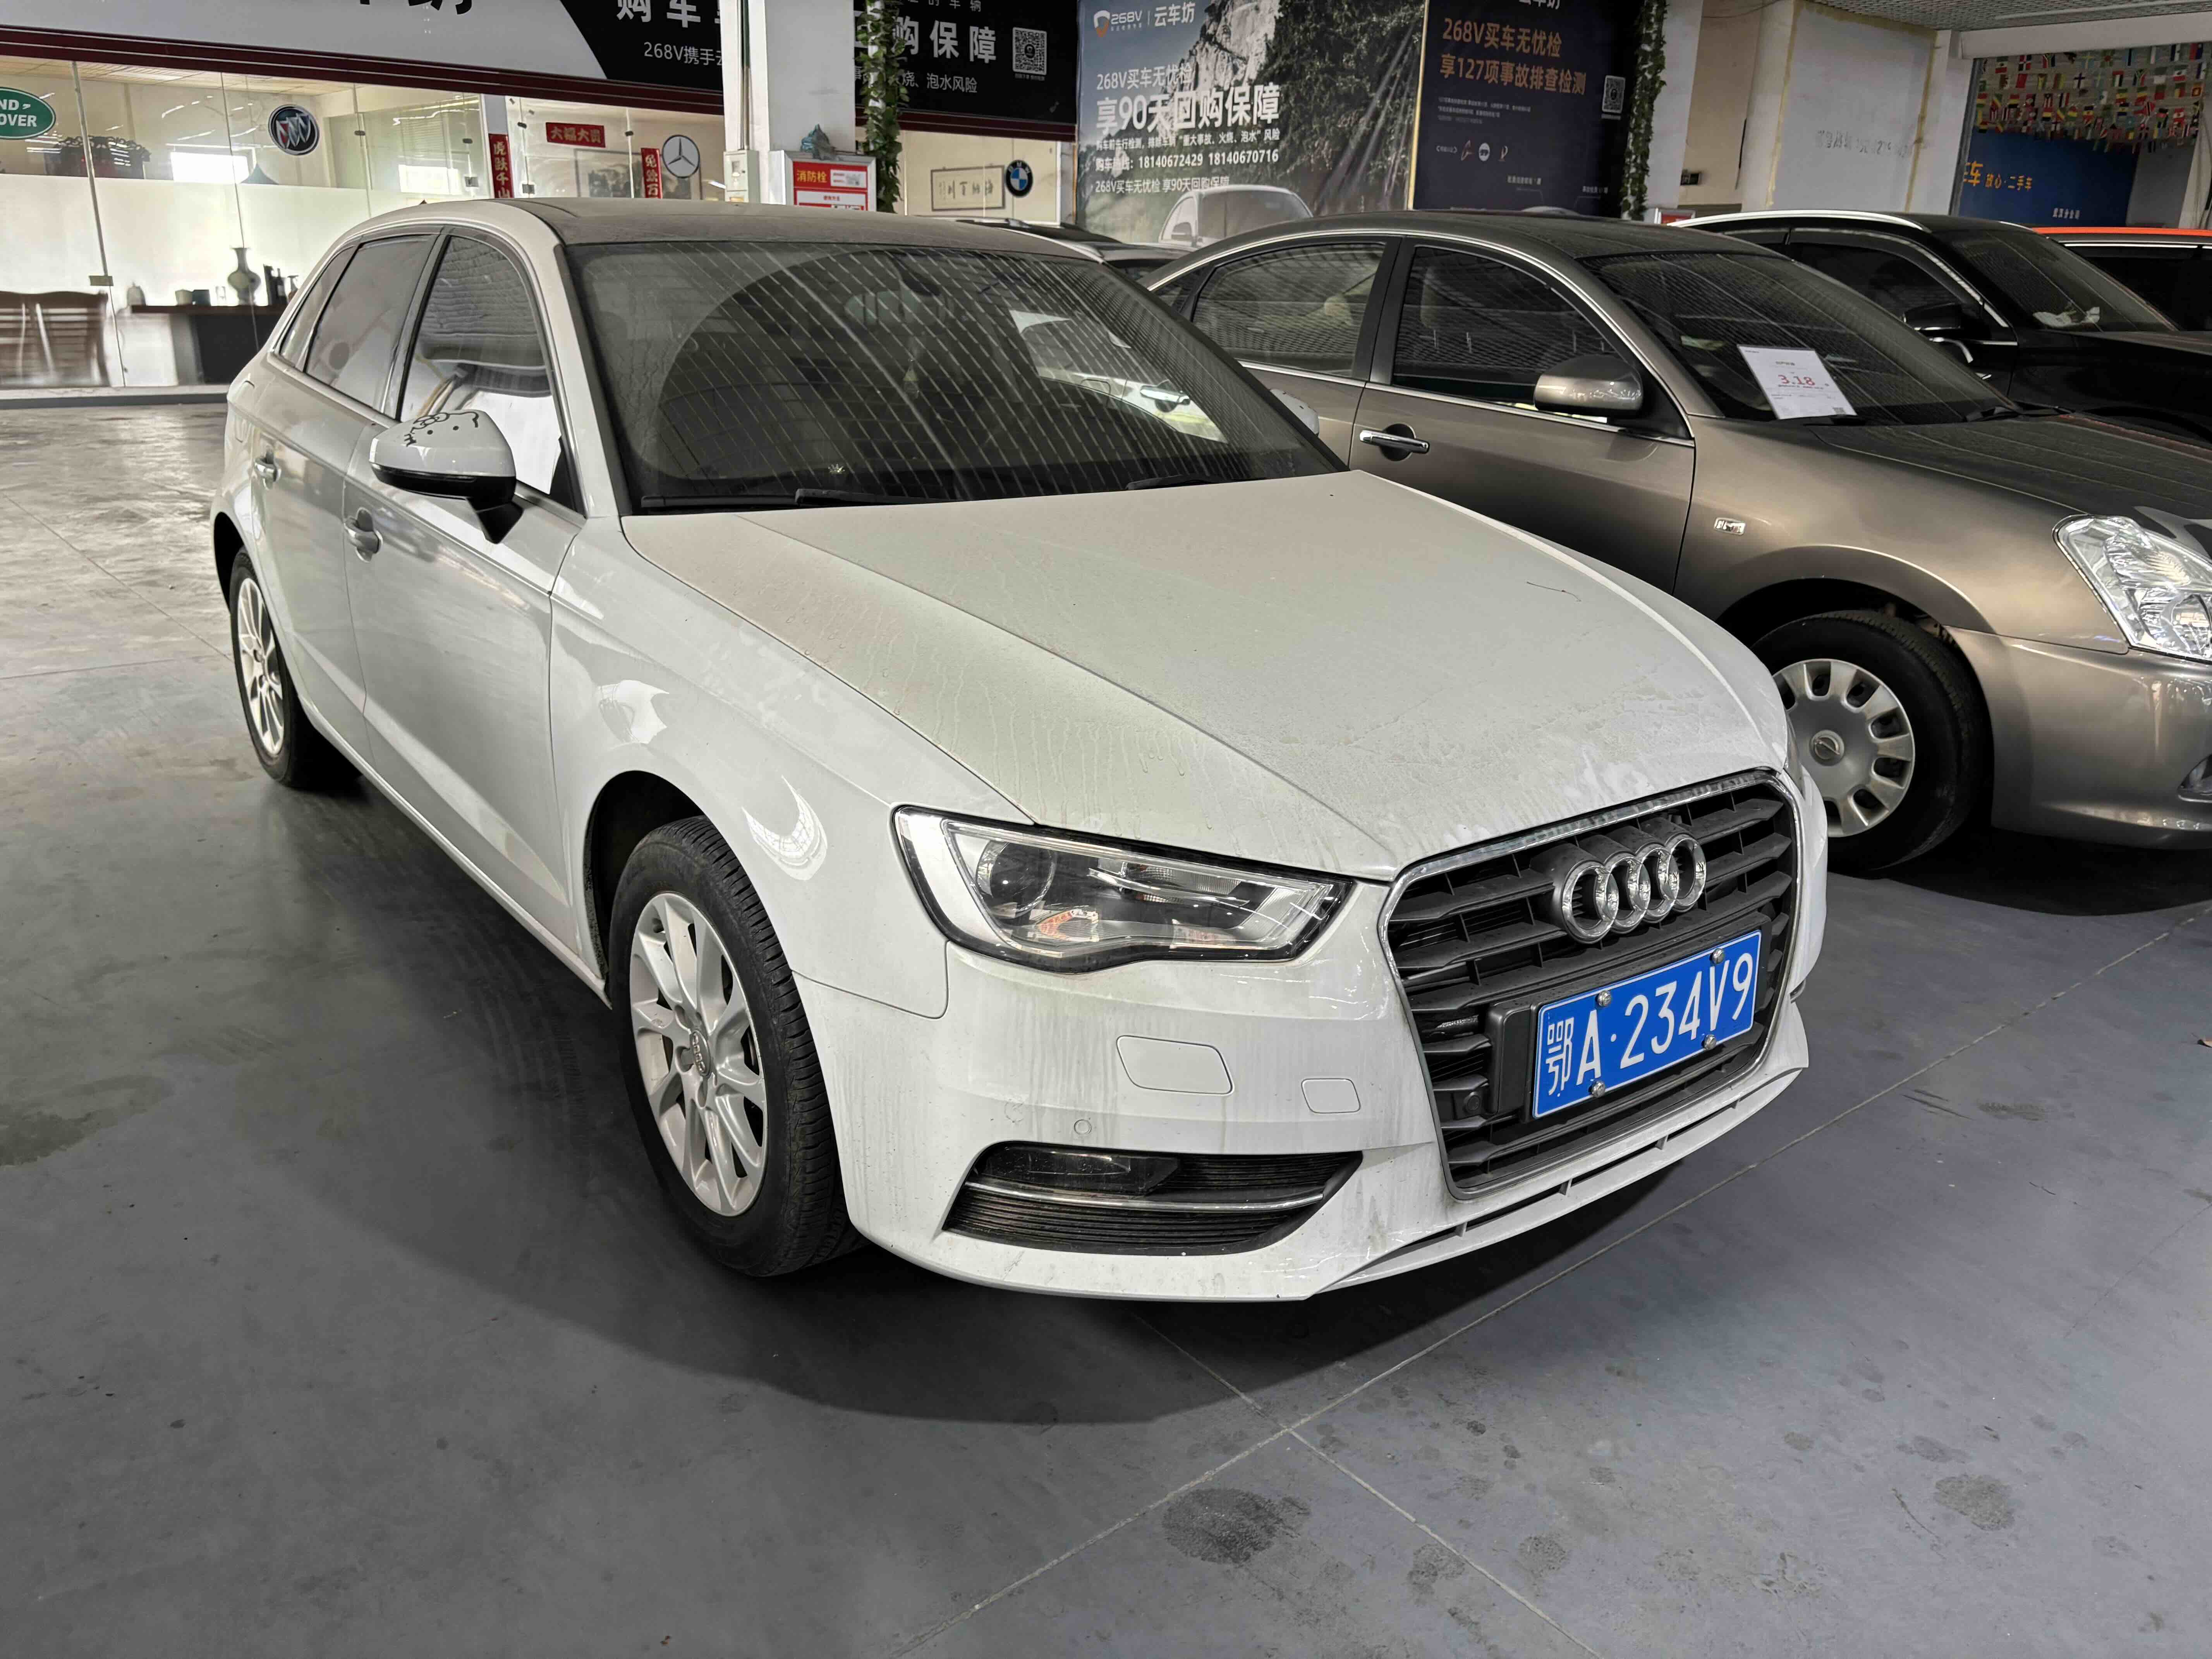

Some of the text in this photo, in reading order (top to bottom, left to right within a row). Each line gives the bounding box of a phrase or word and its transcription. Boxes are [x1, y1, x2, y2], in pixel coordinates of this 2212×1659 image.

[617, 0, 720, 27] 购车
[1111, 2, 1195, 27] 268V 云车坊
[854, 10, 996, 64] 购保障
[1443, 17, 1562, 58] 268V买车无忧检
[1096, 63, 1192, 90] 268V买车无忧检
[1440, 52, 1587, 95] 享127项事故排查检测
[0, 99, 19, 110] ND
[1096, 82, 1280, 135] 享90天回购保障
[0, 113, 37, 127] OVER
[1139, 153, 1203, 168] 18140672429
[1208, 149, 1278, 165] 18140670716
[797, 169, 827, 183] 消防栓
[1095, 178, 1161, 194] 268V买车无忧检
[1778, 374, 1815, 385] 3.18
[1546, 952, 1753, 1096] 鄂A·234V9
